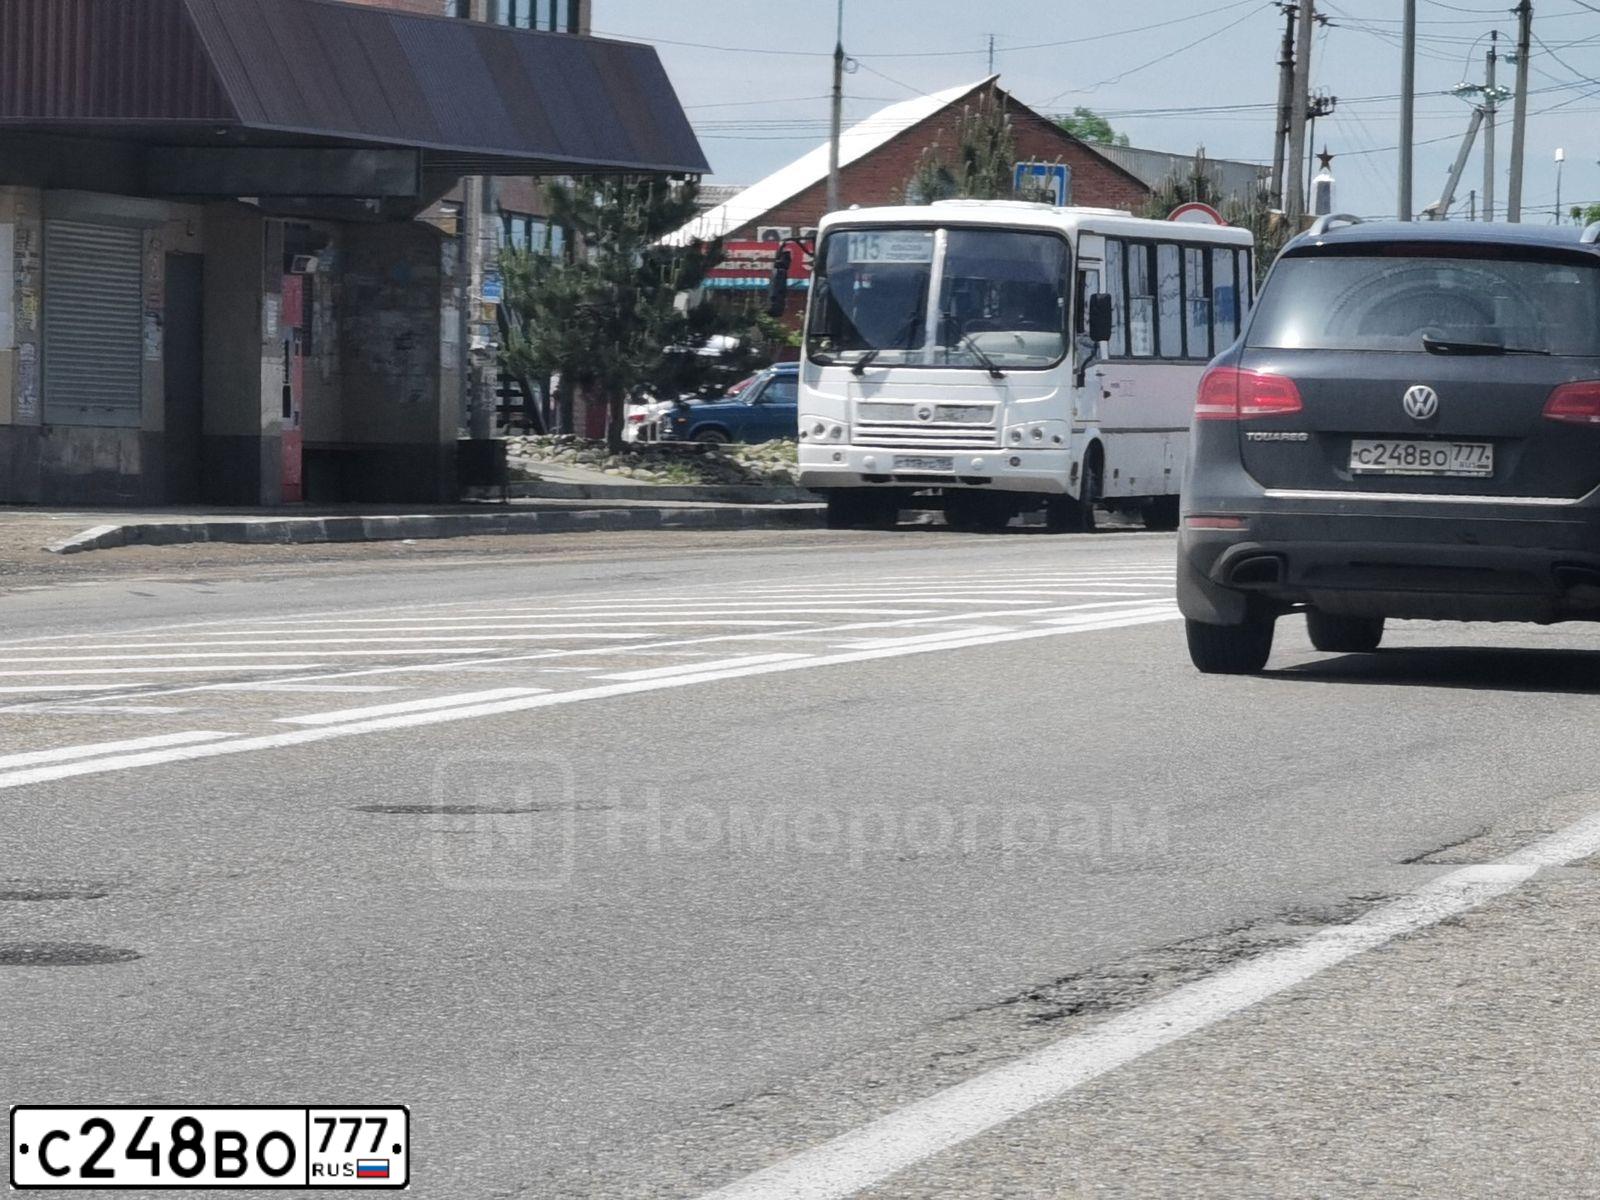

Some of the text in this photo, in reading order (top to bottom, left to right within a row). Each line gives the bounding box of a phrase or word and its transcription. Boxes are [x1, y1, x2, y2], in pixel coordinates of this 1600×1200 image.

[850, 234, 880, 260] 115
[1246, 431, 1309, 442] TOUAREG
[1453, 444, 1487, 462] 777
